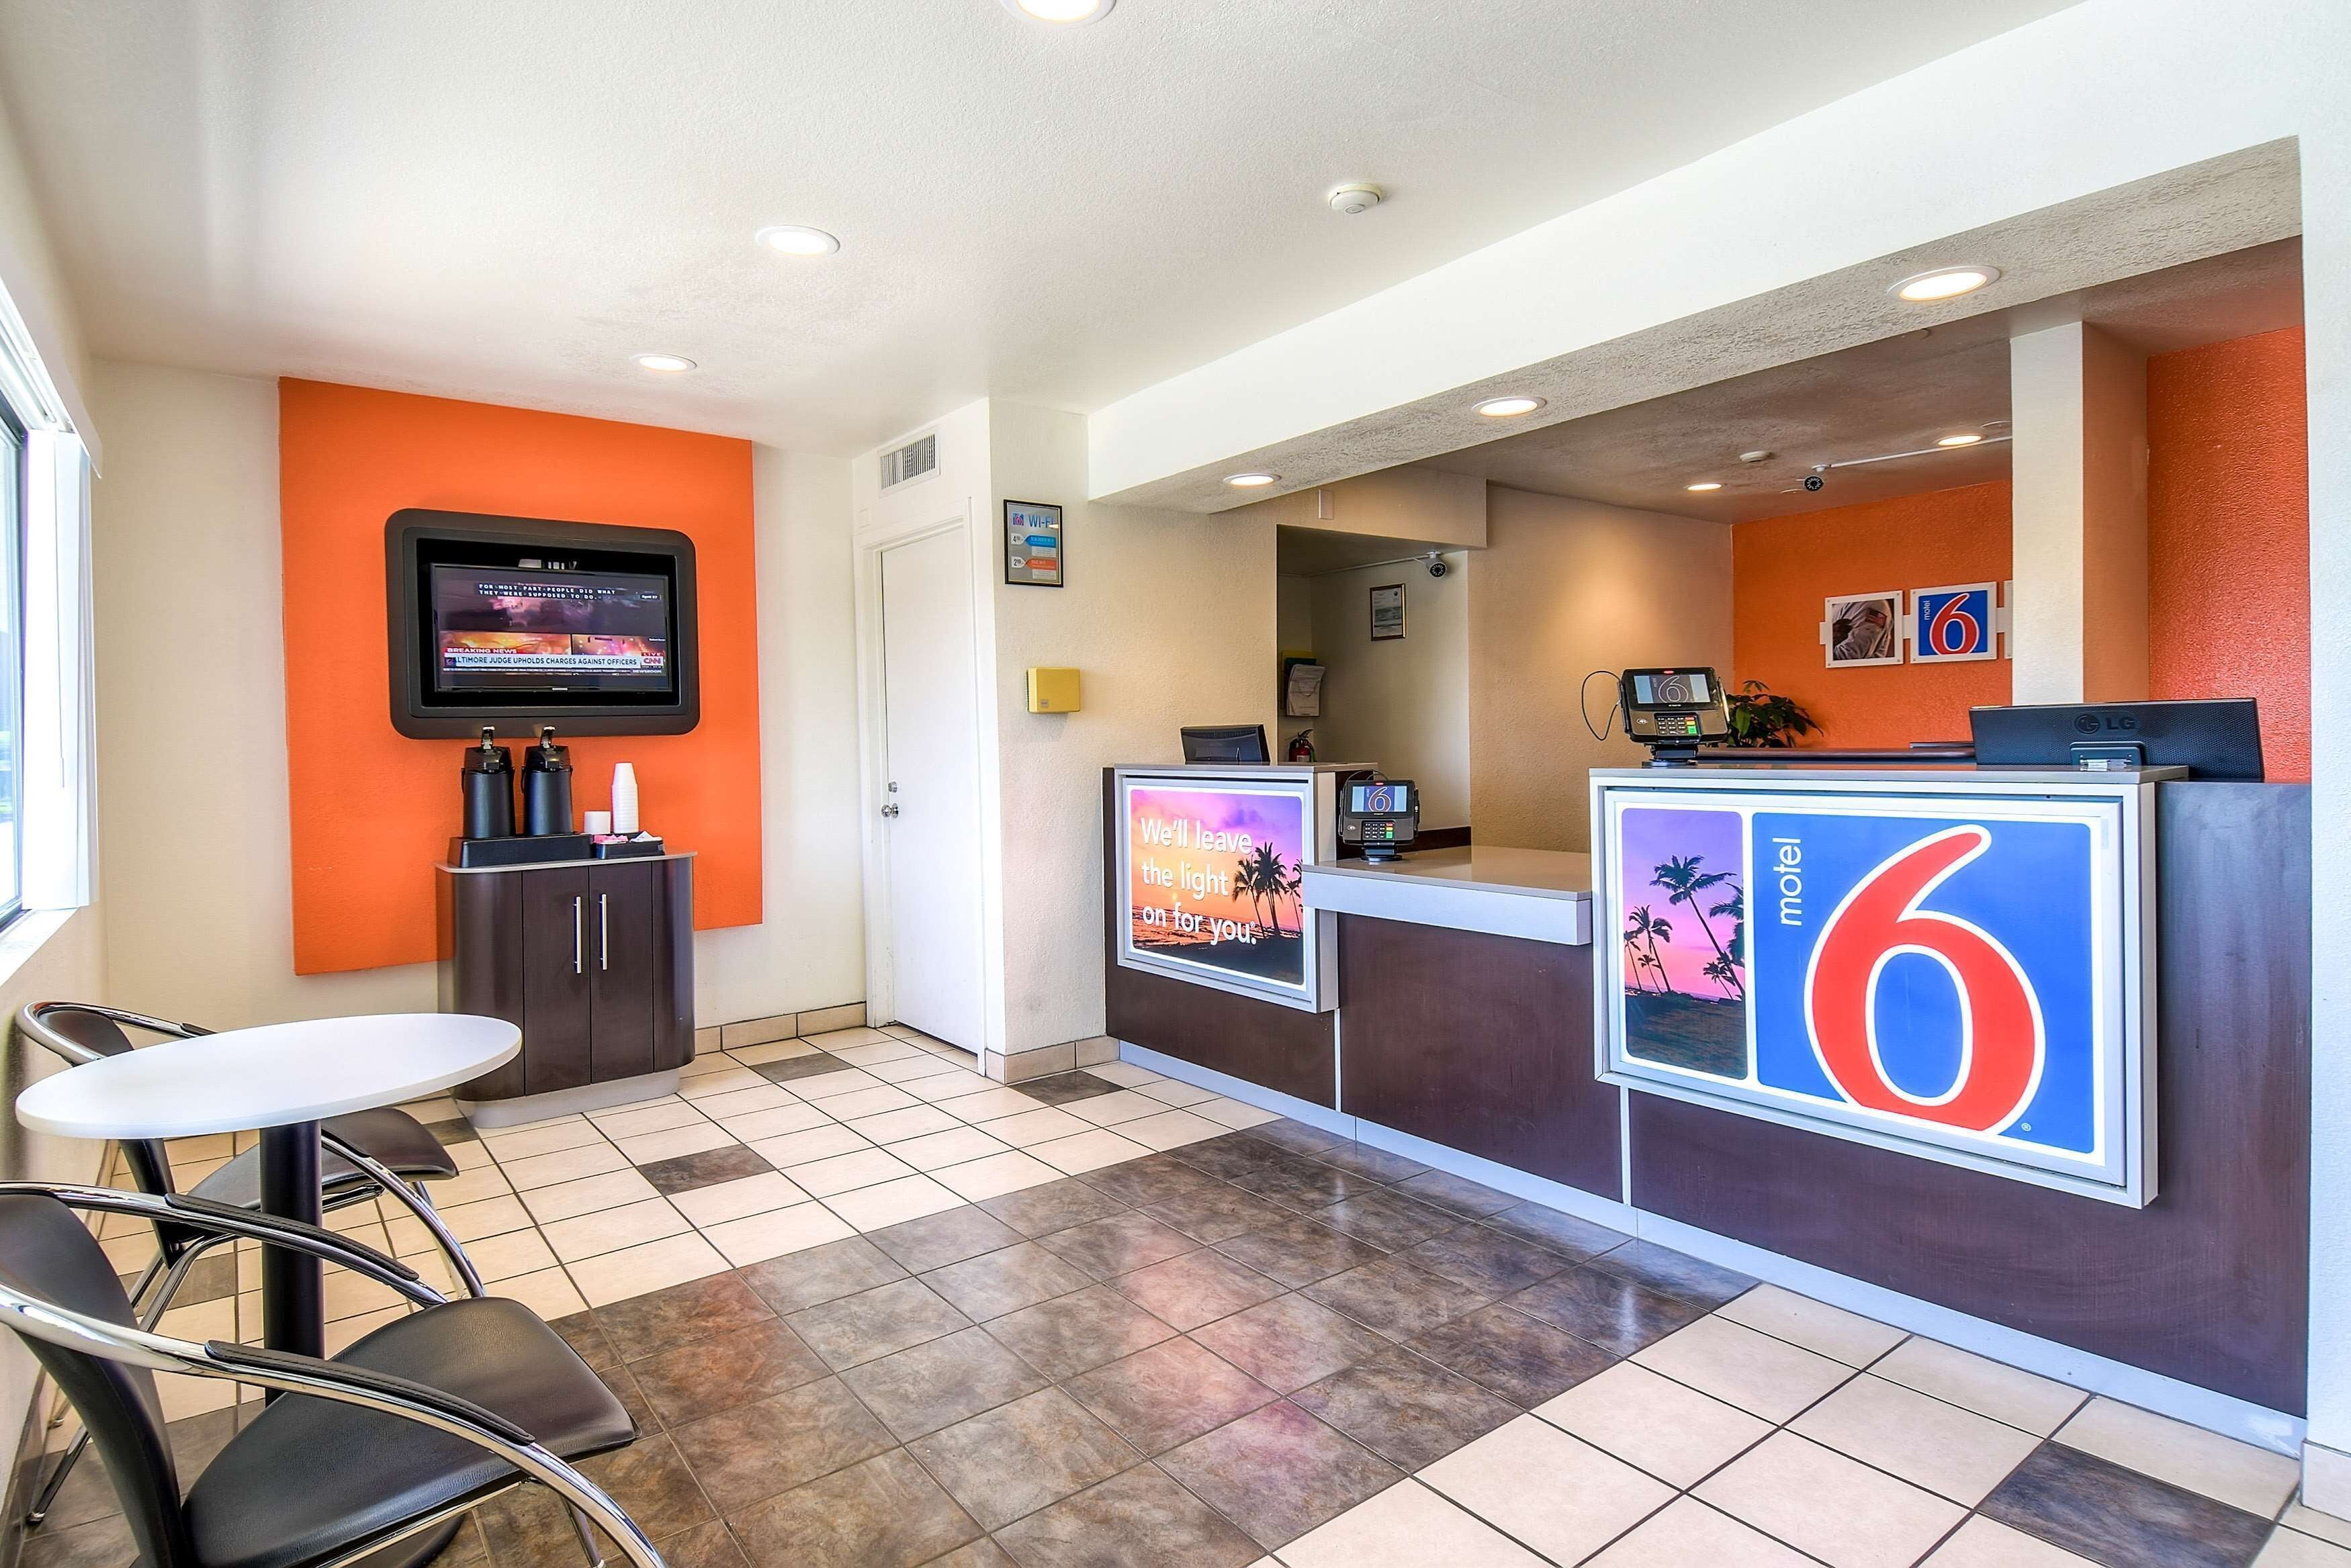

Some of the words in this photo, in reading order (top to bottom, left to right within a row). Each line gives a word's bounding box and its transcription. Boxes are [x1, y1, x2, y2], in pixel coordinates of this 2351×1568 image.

[1929, 592, 1980, 656] 6
[1658, 676, 1689, 703] 6
[2106, 717, 2135, 730] LG
[1368, 786, 1391, 813] 6
[1141, 817, 1188, 848] We'll
[1195, 819, 1253, 854] leave
[1141, 857, 1173, 888] the
[1180, 860, 1229, 901] light
[1143, 905, 1167, 927] on
[1173, 902, 1203, 933] for
[1773, 837, 1802, 927] motel
[1804, 824, 2046, 1136] 6
